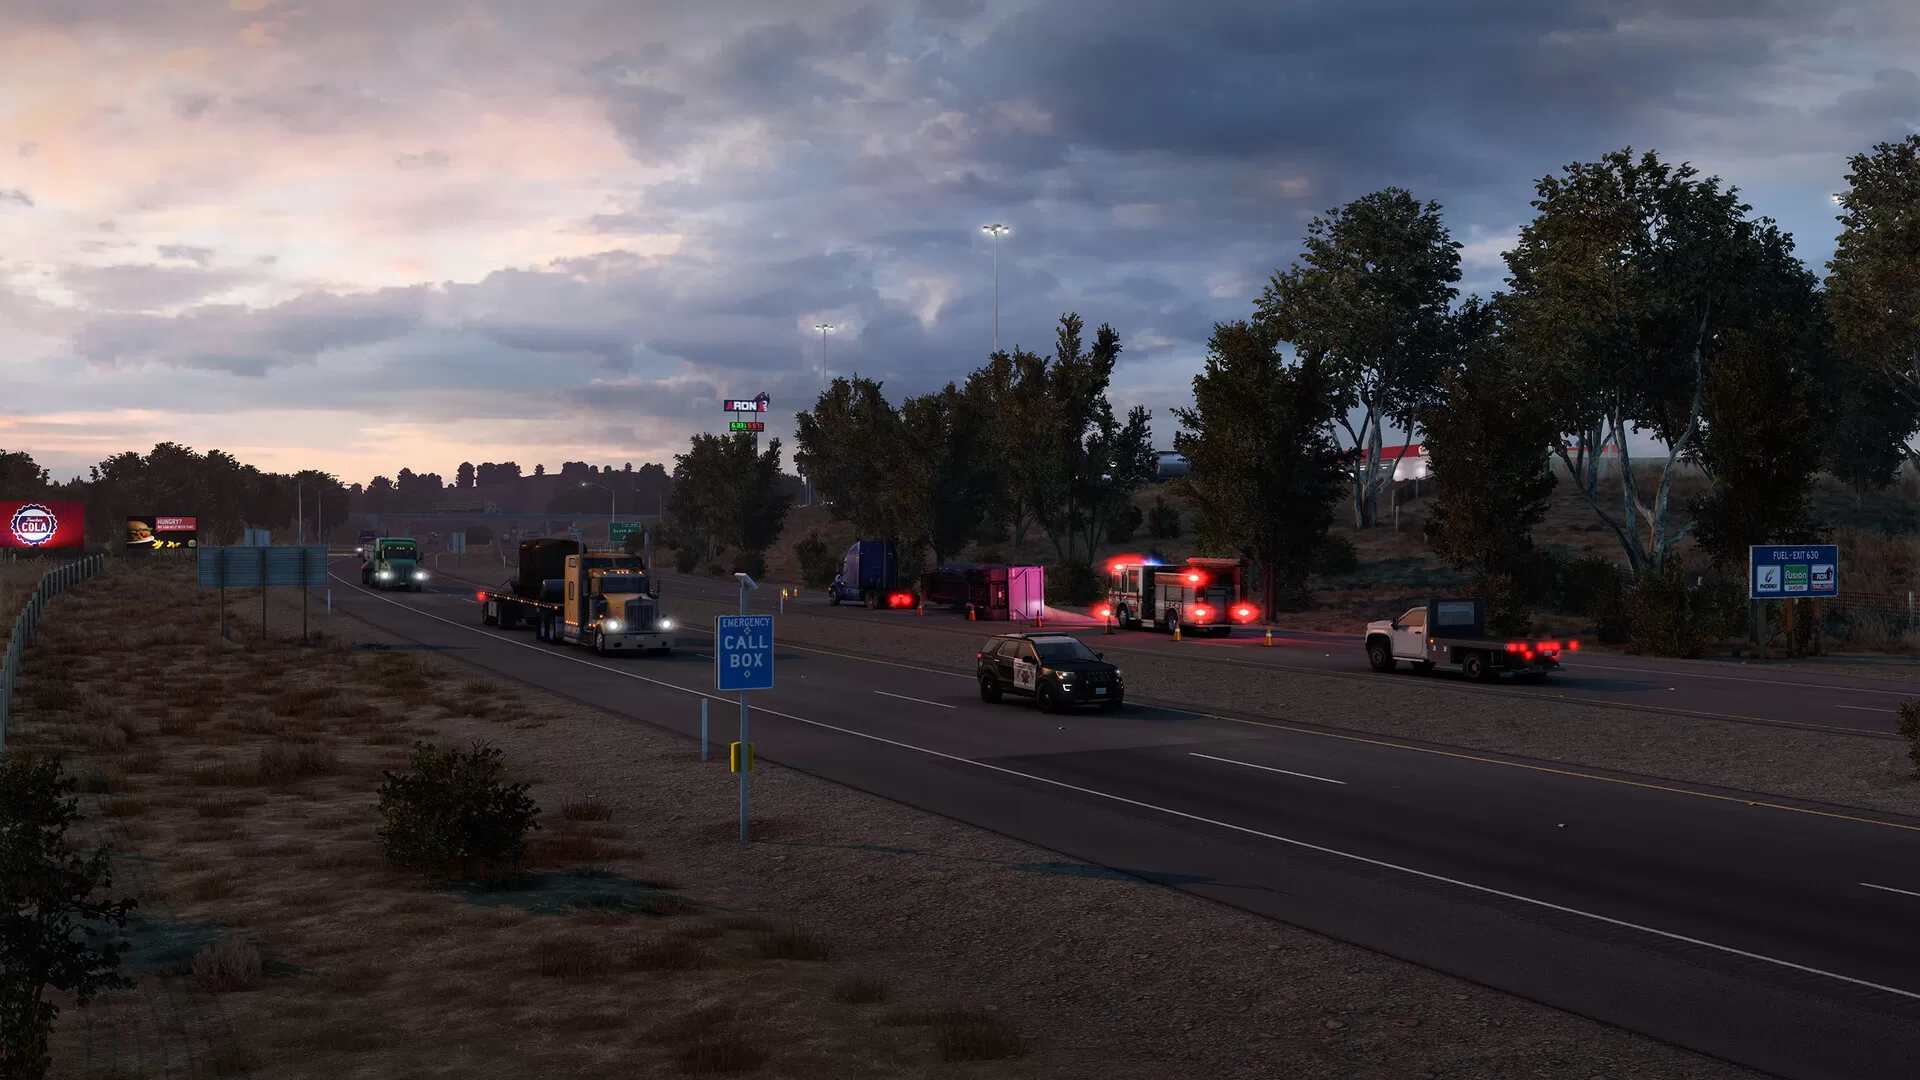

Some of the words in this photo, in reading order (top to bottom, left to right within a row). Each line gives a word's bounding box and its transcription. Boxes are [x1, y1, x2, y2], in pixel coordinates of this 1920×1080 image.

[726, 401, 757, 411] ARON
[21, 522, 48, 532] COLA
[1773, 551, 1789, 560] FUEL
[1792, 551, 1806, 560] EXIT
[1806, 550, 1819, 560] 630
[722, 617, 770, 628] EMERGENCY
[724, 635, 769, 650] CALL
[730, 652, 764, 668] BOX
